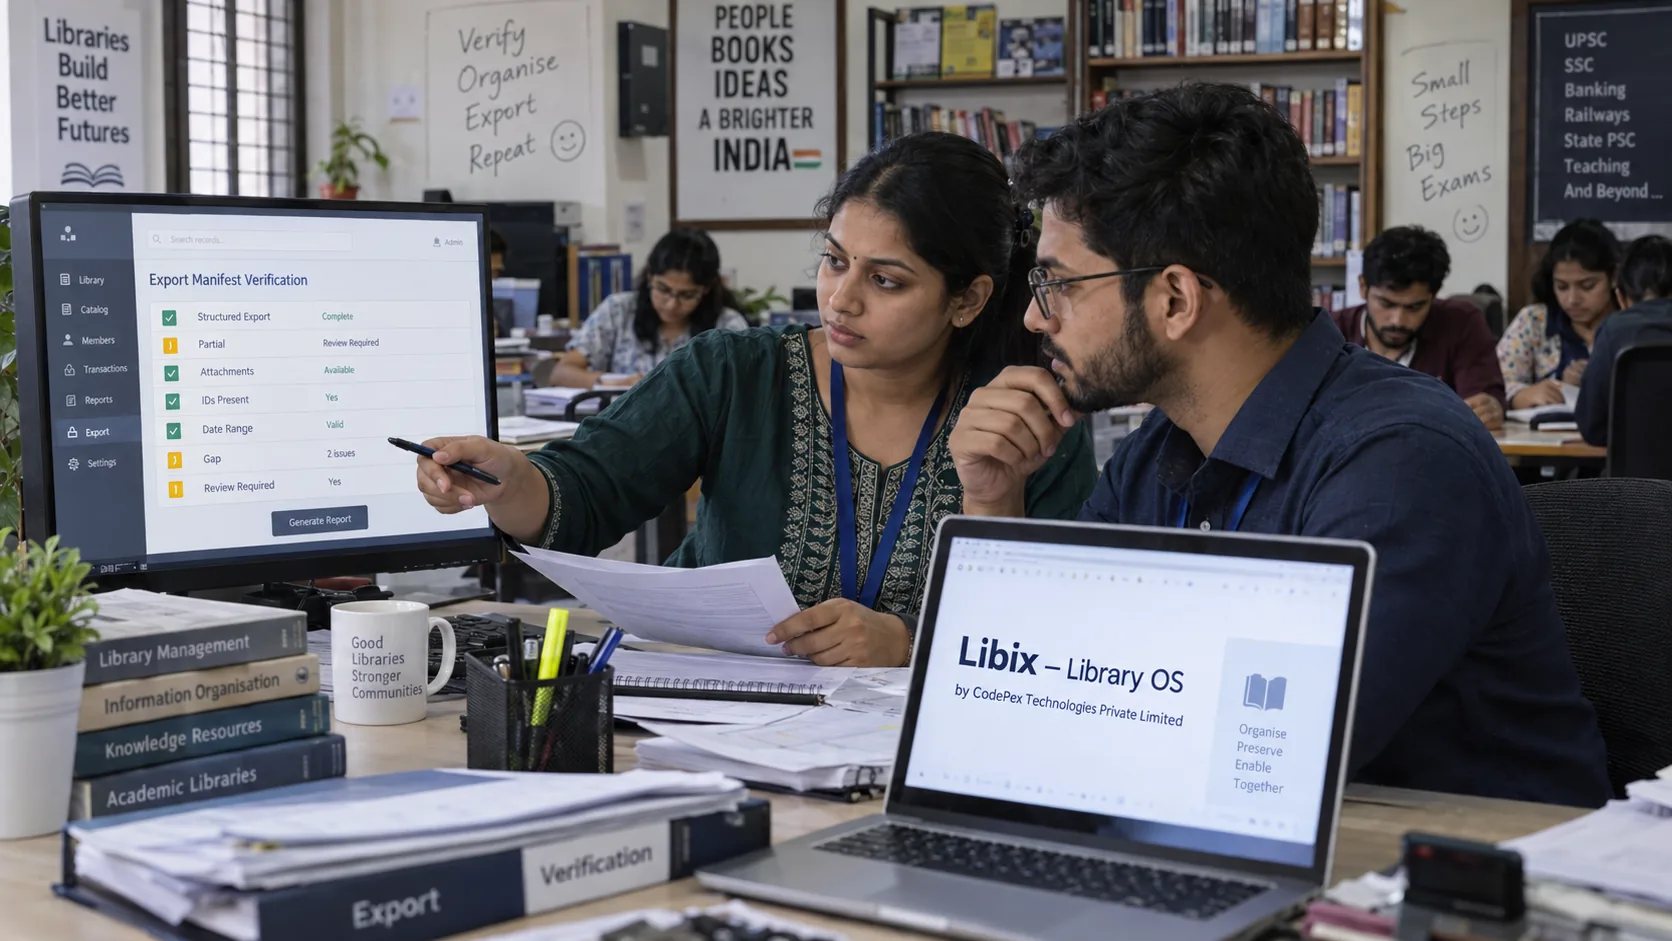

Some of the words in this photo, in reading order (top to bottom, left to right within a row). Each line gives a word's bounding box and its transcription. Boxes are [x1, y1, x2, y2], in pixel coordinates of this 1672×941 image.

[715, 4, 793, 31] PEOPLE
[43, 17, 130, 52] Libraries
[457, 19, 527, 58] Verify
[1564, 32, 1607, 48] UPSC
[711, 35, 795, 64] BOOKS
[58, 52, 108, 81] Build
[1564, 57, 1594, 73] SSC
[457, 53, 559, 100] Organise
[714, 69, 789, 99] IDEAS
[1411, 60, 1470, 98] Small
[57, 85, 116, 113] Better
[1564, 82, 1626, 100] Banking
[465, 94, 538, 136] Export
[699, 109, 710, 130] A
[719, 107, 814, 130] BRIGHTER
[1421, 99, 1482, 130] Steps
[1564, 107, 1630, 127] Railways
[58, 117, 130, 144] Futures
[1564, 133, 1603, 148] State
[1607, 132, 1636, 148] PSC
[469, 133, 536, 177] Repeat
[713, 138, 791, 172] INDIA
[1406, 142, 1445, 171] Big
[1564, 158, 1630, 177] Teaching
[1420, 165, 1492, 202] Exams
[1564, 183, 1592, 199] And
[445, 239, 463, 247] Admin
[79, 276, 104, 286] Library
[149, 273, 189, 289] Export
[192, 272, 242, 286] Manifest
[244, 272, 308, 286] Verification
[81, 305, 109, 316] Catalog
[197, 312, 241, 322] Structured
[244, 312, 271, 324] Export
[322, 312, 354, 322] Complete
[81, 336, 115, 346] Members
[198, 339, 226, 349] Partial
[323, 338, 347, 347] Review
[349, 338, 380, 348] Required
[84, 364, 128, 374] Transactions
[200, 367, 254, 377] Attachments
[324, 366, 355, 375] Available
[85, 395, 113, 405] Reports
[201, 396, 216, 405] IDs
[217, 395, 249, 405] Present
[325, 393, 338, 402] Yes
[202, 425, 223, 434] Date
[226, 424, 254, 436] Range
[326, 420, 344, 429] Valid
[85, 428, 110, 438] Export
[203, 454, 222, 465] Gap
[327, 450, 332, 458] 2
[333, 449, 356, 458] issues
[87, 458, 117, 468] Settings
[204, 483, 235, 493] Review
[237, 480, 275, 492] Required
[328, 477, 342, 486] Yes
[289, 517, 324, 527] Generate
[326, 514, 352, 526] Report
[99, 649, 152, 668] Library
[157, 634, 250, 660] Management
[352, 636, 383, 650] Good
[352, 652, 405, 666] Libraries
[958, 635, 1040, 675] Libix
[1067, 658, 1144, 693] Library
[1150, 668, 1185, 694] OS
[352, 670, 401, 685] Stronger
[104, 688, 192, 715] Information
[195, 673, 280, 702] Organisation
[352, 684, 423, 700] Communities
[955, 684, 970, 699] by
[972, 686, 1023, 705] CodePex
[1025, 692, 1097, 715] Technologies
[1099, 702, 1137, 720] Private
[1140, 709, 1183, 727] Limited
[105, 731, 187, 760] Knowledge
[192, 720, 262, 745] Resources
[1239, 723, 1287, 741] Organise
[1237, 741, 1283, 757] Preserve
[1235, 759, 1272, 774] Enable
[107, 780, 184, 808] Academic
[189, 767, 257, 793] Libraries
[1233, 777, 1284, 796] Together
[352, 888, 441, 929] Export
[540, 845, 653, 886] Verification
